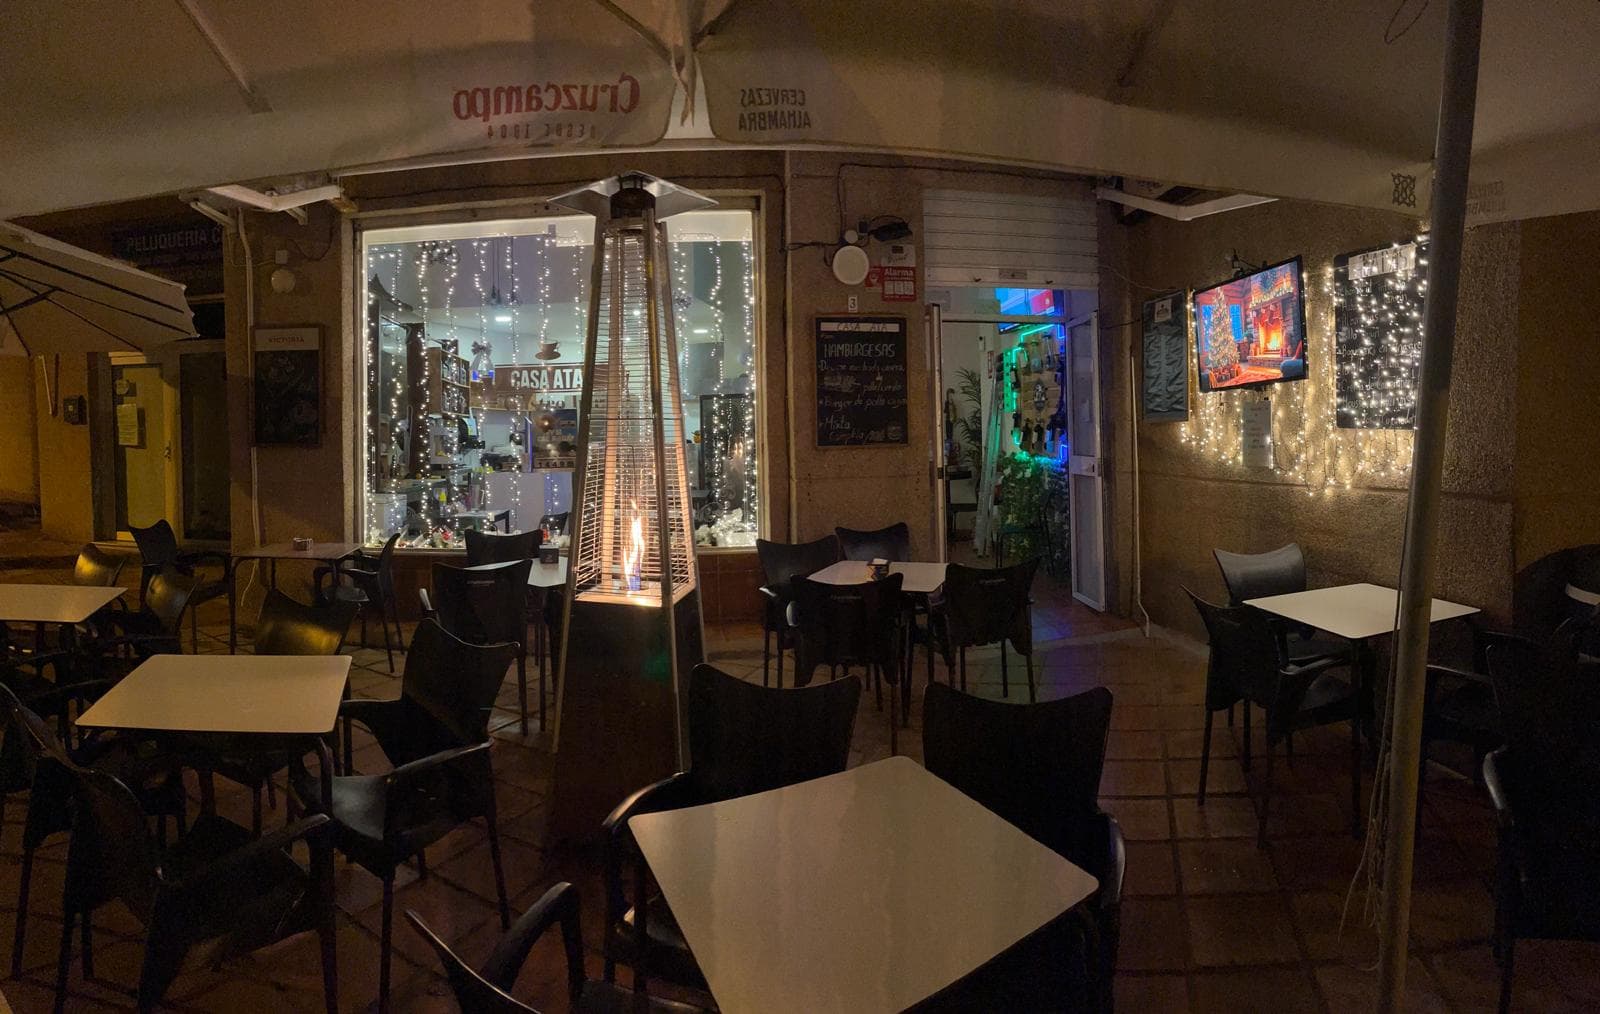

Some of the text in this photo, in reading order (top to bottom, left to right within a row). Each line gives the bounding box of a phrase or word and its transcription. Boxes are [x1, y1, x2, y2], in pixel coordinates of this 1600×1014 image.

[849, 297, 857, 310] 3
[511, 368, 583, 389] CASA ATA
